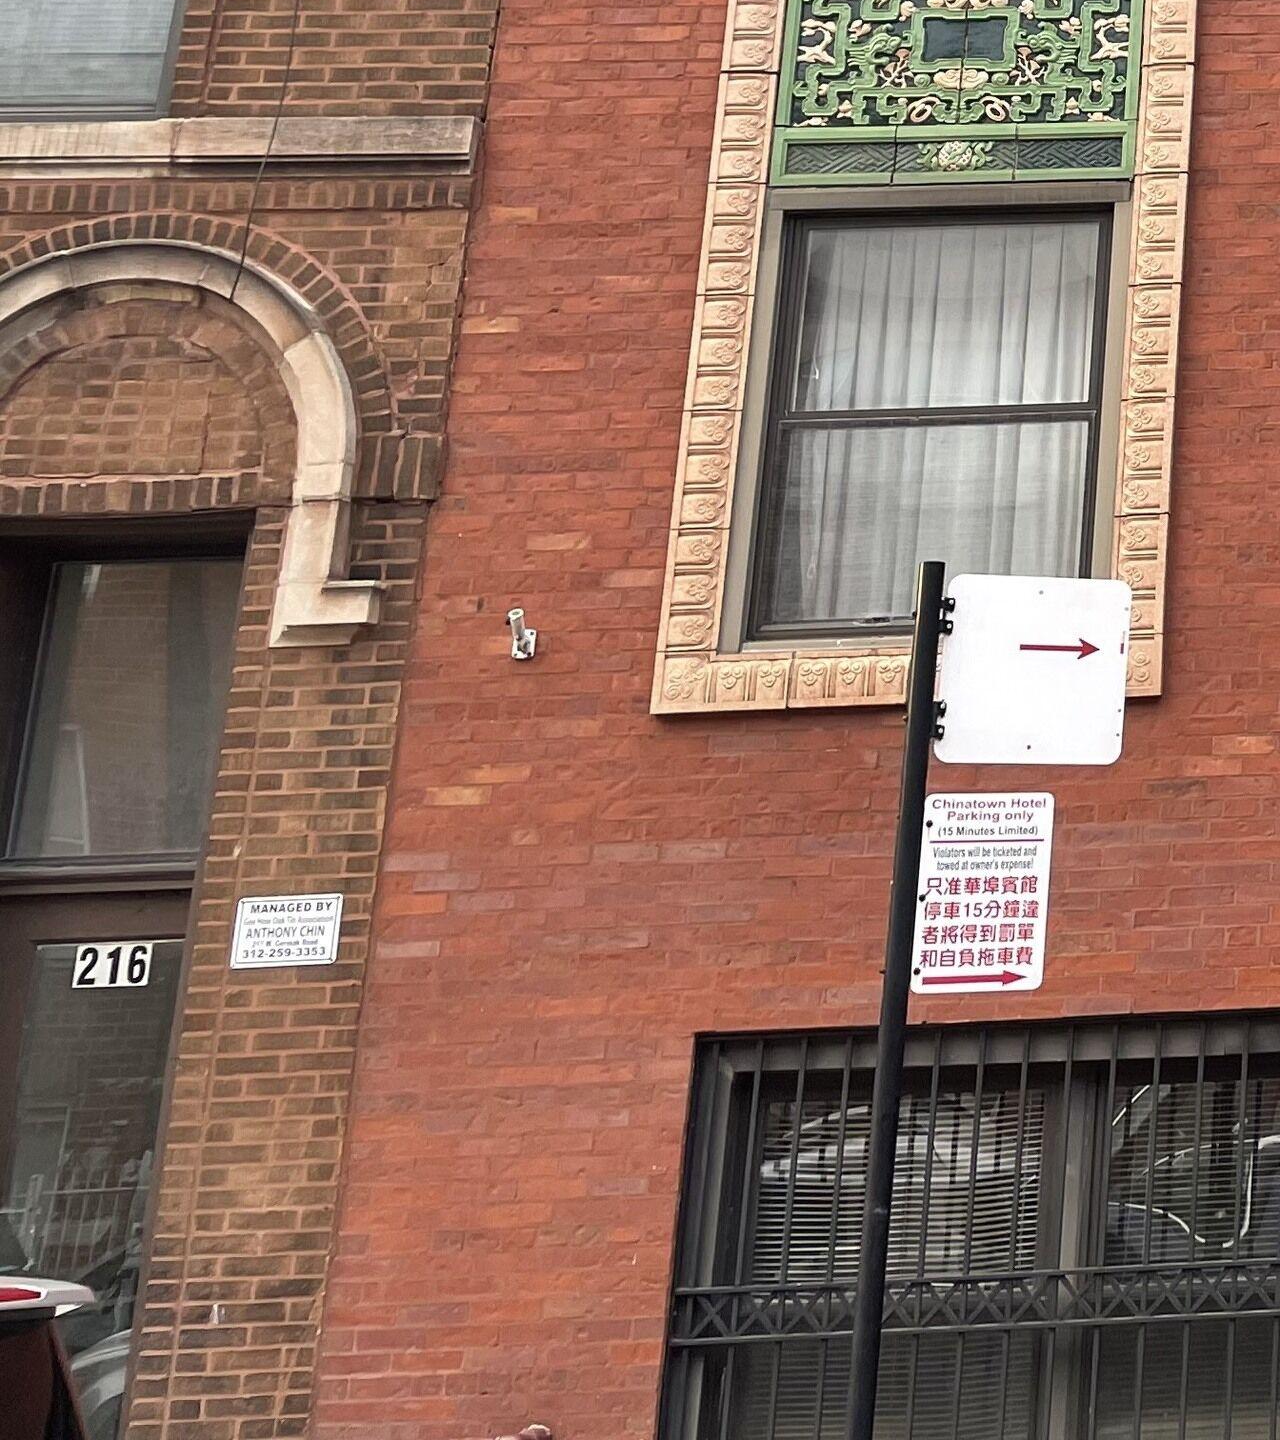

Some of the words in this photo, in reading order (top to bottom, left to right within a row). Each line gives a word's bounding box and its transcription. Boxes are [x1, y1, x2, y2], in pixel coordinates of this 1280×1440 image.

[932, 799, 1006, 809] Chinatown
[1011, 798, 1046, 808] Hotel
[947, 811, 1000, 823] Parking
[1005, 810, 1034, 822] only
[938, 827, 953, 837] (15
[956, 826, 995, 836] Minutes
[998, 825, 1039, 836] Limited)
[933, 847, 966, 858] Violators
[967, 847, 981, 857] will
[981, 846, 992, 857] be
[993, 846, 1022, 857] ticketed
[1023, 845, 1037, 856] and
[936, 860, 960, 871] towed
[961, 860, 969, 870] at
[250, 903, 312, 914] MANAGED
[316, 902, 333, 912] BY
[246, 926, 298, 939] ANTHONY
[300, 925, 326, 937] CHIN
[76, 945, 148, 985] 216
